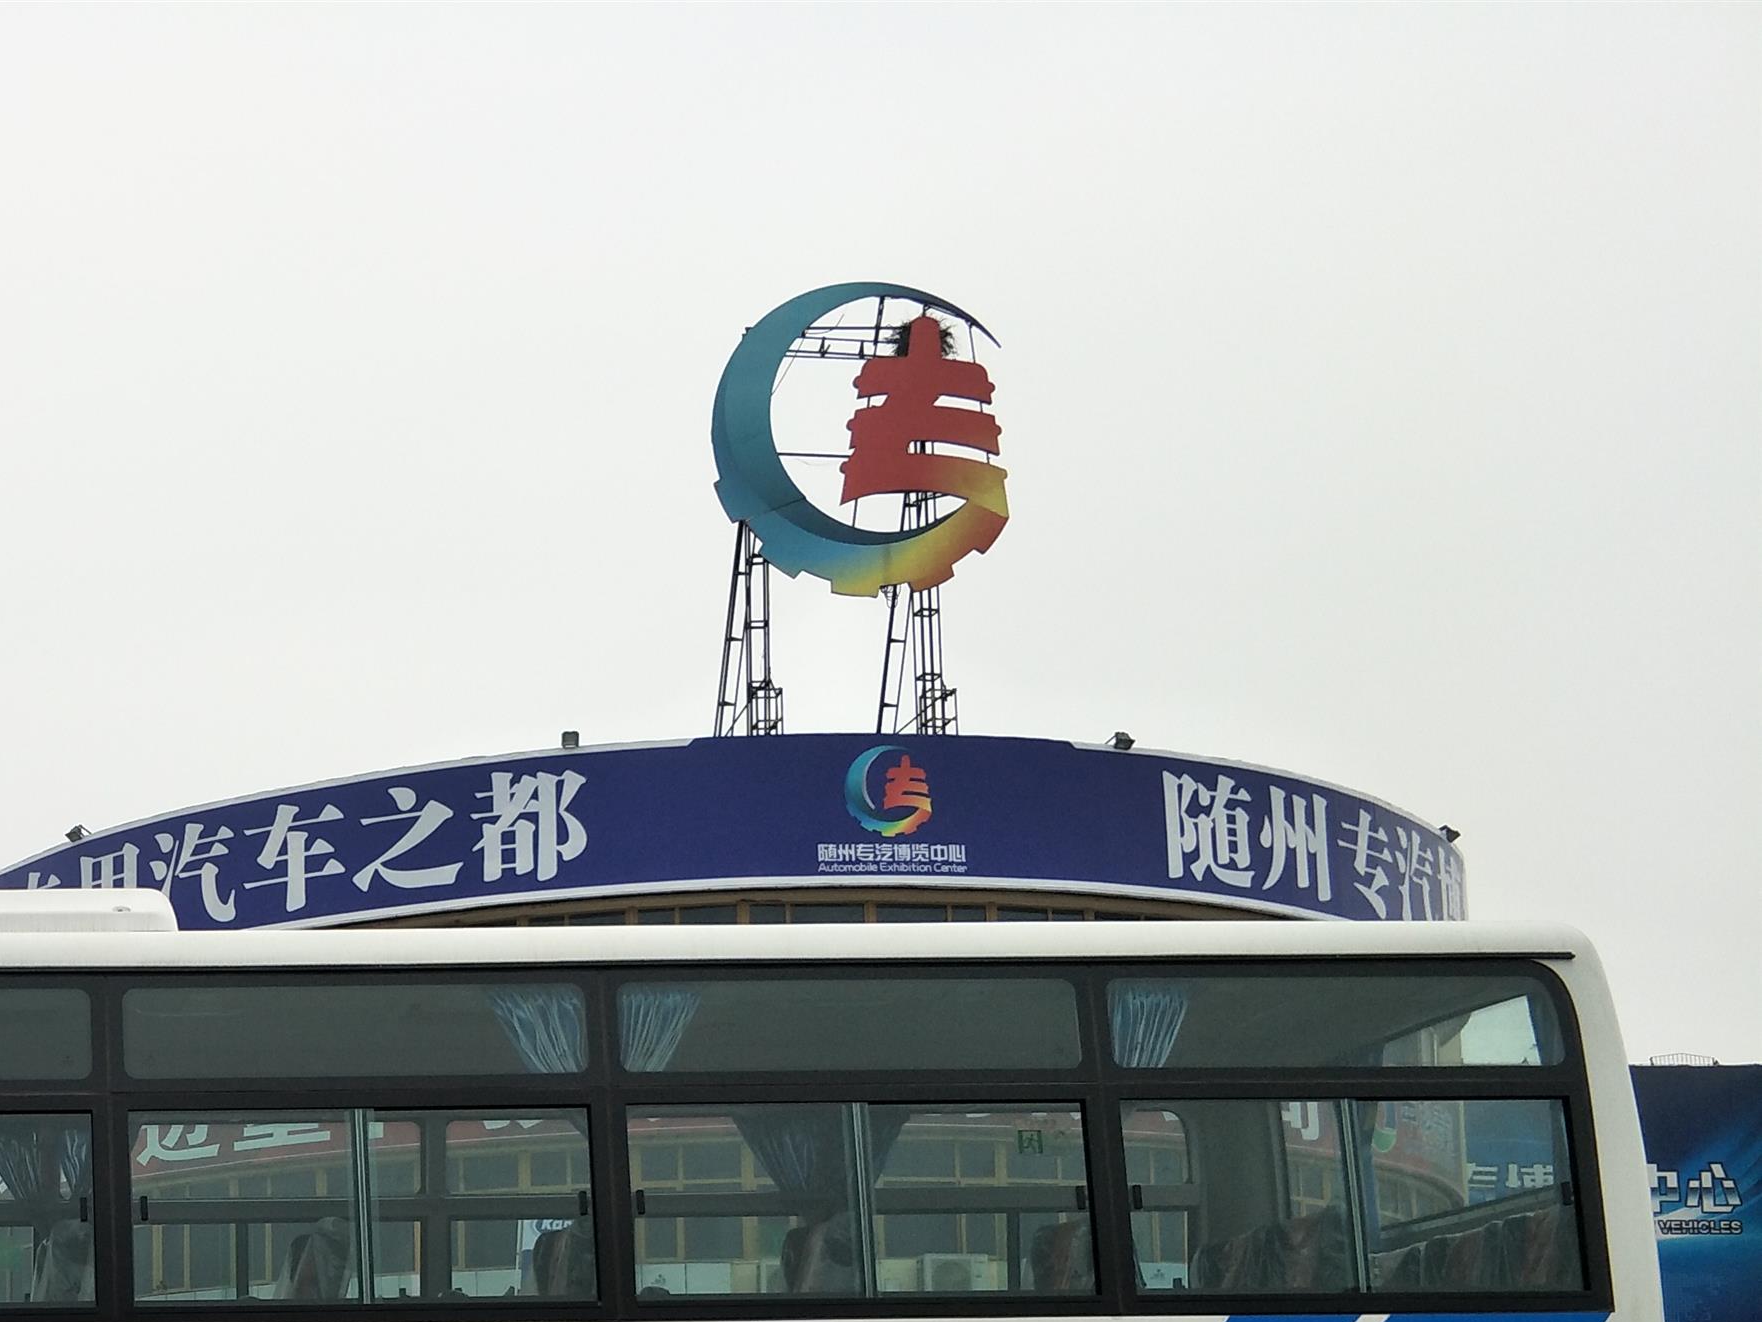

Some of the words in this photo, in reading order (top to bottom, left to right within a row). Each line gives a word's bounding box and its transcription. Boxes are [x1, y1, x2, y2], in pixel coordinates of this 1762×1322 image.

[28, 769, 588, 922] 汽车之都
[817, 843, 967, 863] 随州专汽博览中心
[818, 862, 878, 873] Automobile
[879, 862, 933, 873] Exhibition
[933, 863, 968, 873] Center
[1658, 1219, 1743, 1236] VEHICLES
